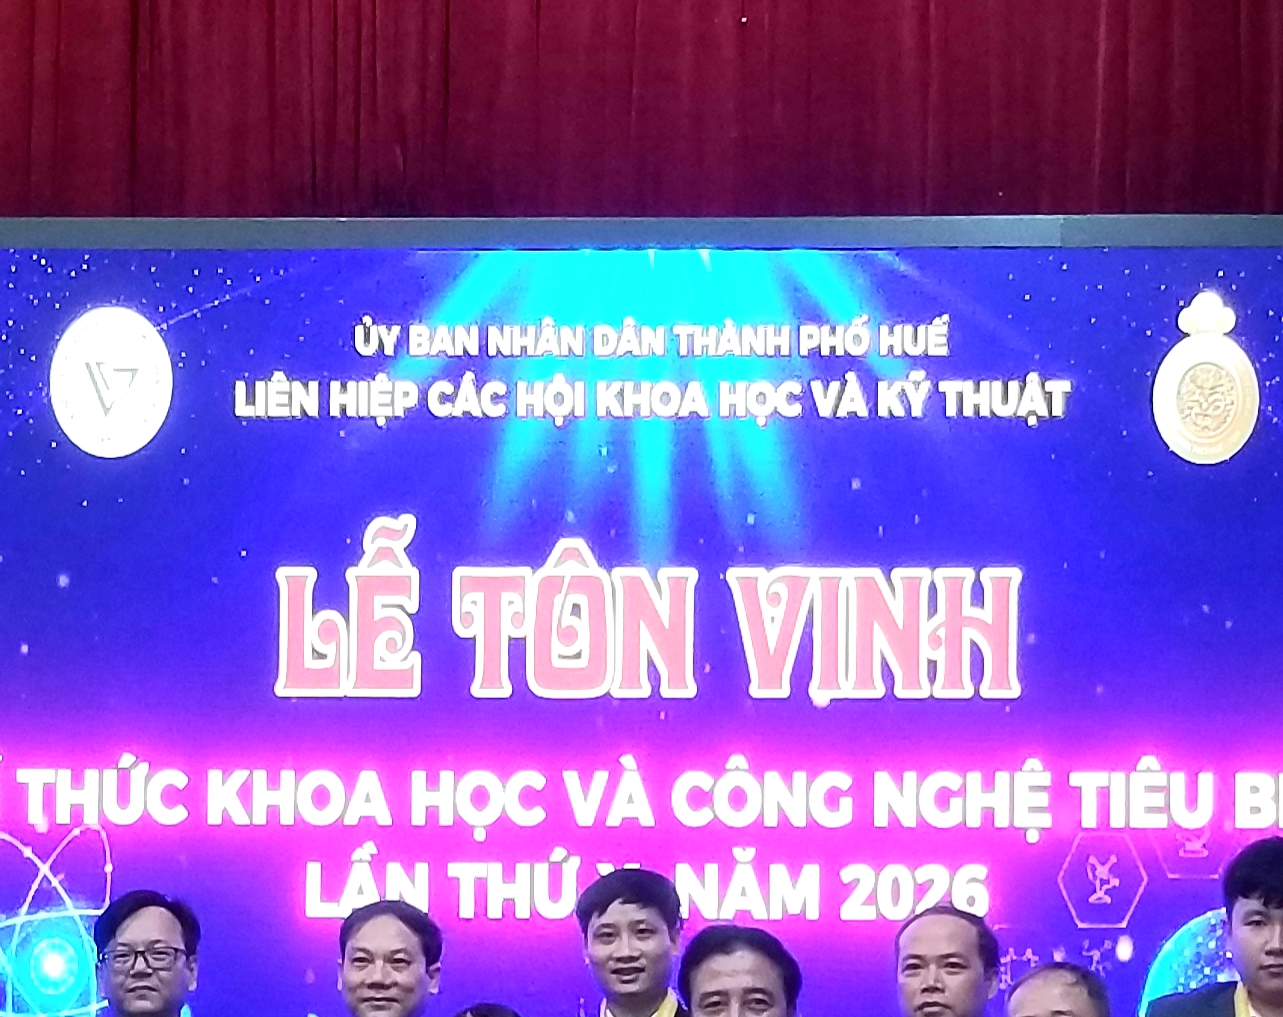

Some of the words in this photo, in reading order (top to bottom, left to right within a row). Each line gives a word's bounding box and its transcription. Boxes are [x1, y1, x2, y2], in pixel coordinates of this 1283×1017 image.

[354, 315, 401, 356] ỦY
[408, 325, 479, 356] BAN
[487, 316, 584, 356] NHÂN
[593, 316, 665, 356] DÂN
[674, 318, 790, 356] THÀNH
[799, 314, 871, 356] PHỐ
[879, 314, 950, 356] HUẾ
[234, 370, 318, 418] LIÊN
[329, 372, 418, 427] HIỆP
[427, 370, 507, 418] CÁC
[516, 373, 585, 427] HỘI
[596, 381, 710, 418] KHOA
[719, 381, 803, 427] HỌC
[810, 371, 869, 418] VÀ
[877, 370, 931, 418] KỸ
[939, 371, 1071, 427] THUẬT
[274, 513, 419, 698] LỄ
[452, 538, 698, 699] TÔN
[726, 566, 1022, 699] VINH
[16, 752, 189, 825] THỨC
[207, 769, 393, 827] KHOA
[411, 770, 547, 843] HỌC
[562, 754, 656, 828] VÀ
[671, 754, 853, 828] CÔNG
[873, 757, 1052, 844] NGHỆ
[1069, 755, 1214, 829] TIÊU
[305, 840, 429, 919] LẦN
[447, 846, 581, 919] THỨ
[675, 847, 820, 920] NĂM
[839, 864, 990, 921] 2026
